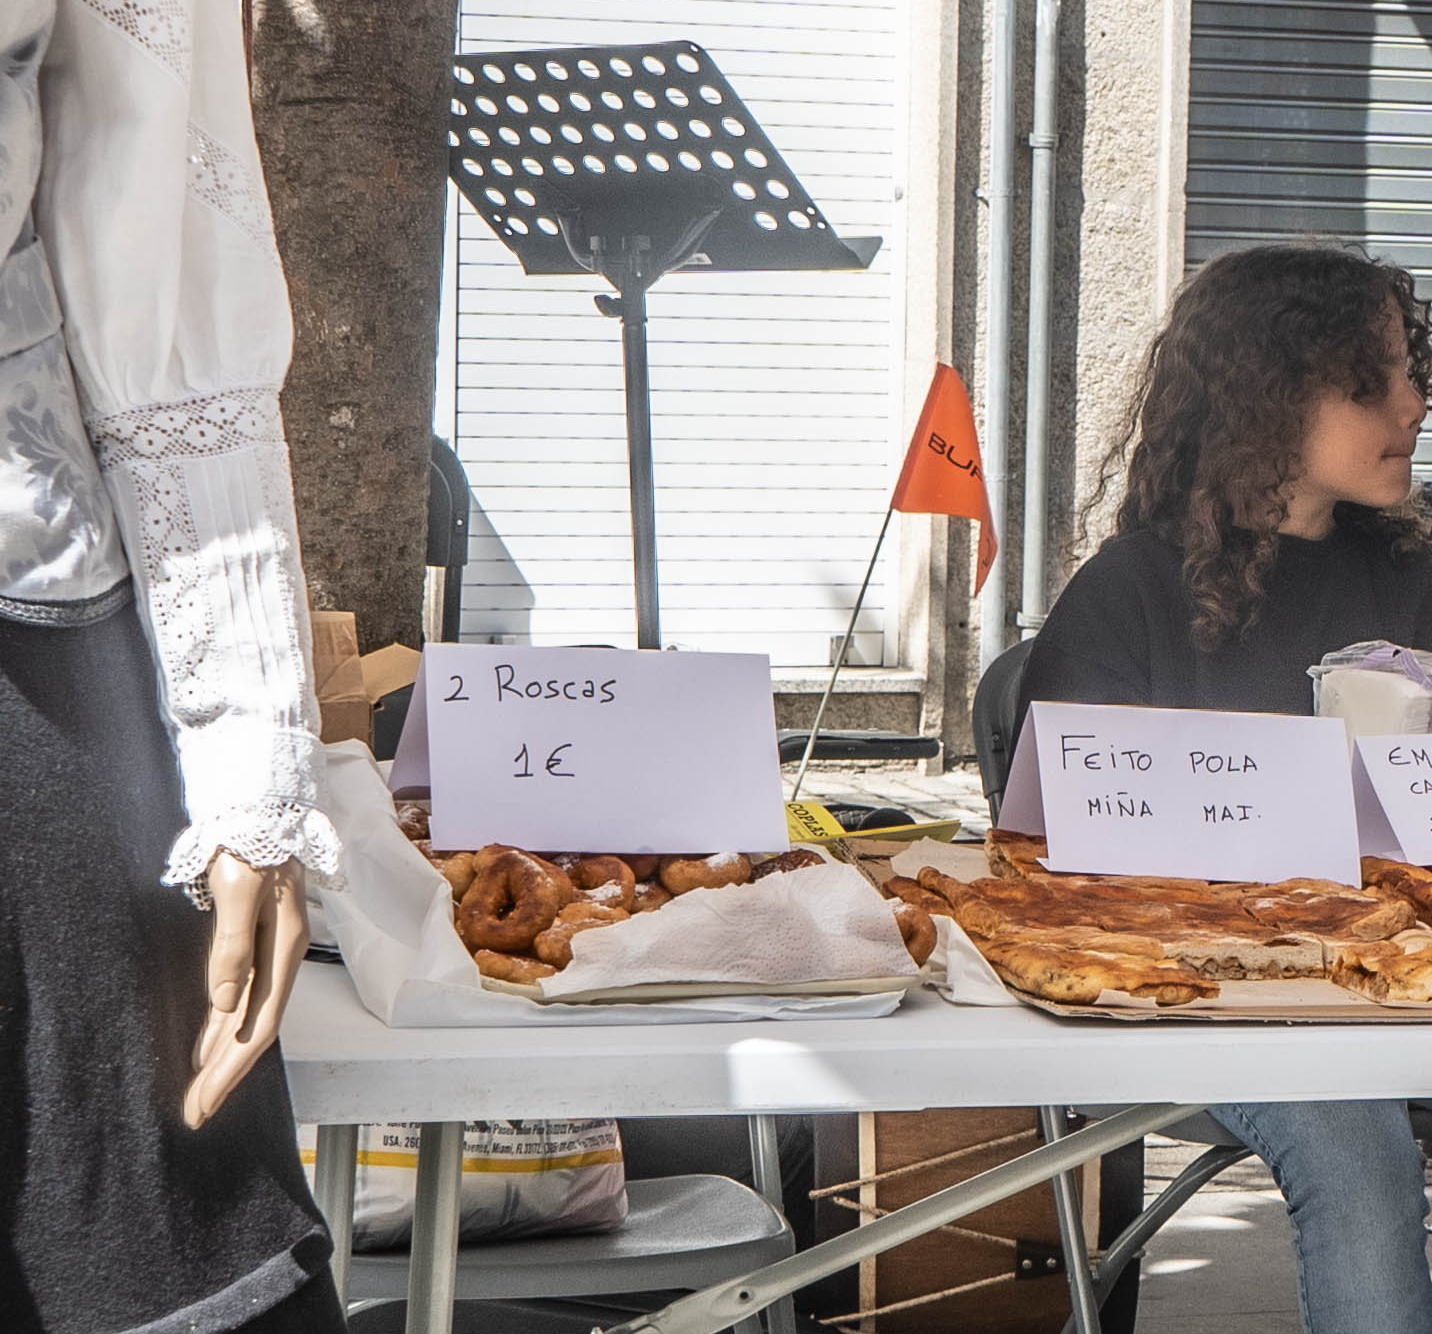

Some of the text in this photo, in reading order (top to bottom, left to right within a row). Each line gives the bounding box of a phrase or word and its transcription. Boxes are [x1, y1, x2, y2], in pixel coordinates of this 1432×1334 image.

[443, 663, 617, 704] 2 Roscas
[1189, 751, 1258, 774] POLA
[787, 803, 829, 837] COPLAS
